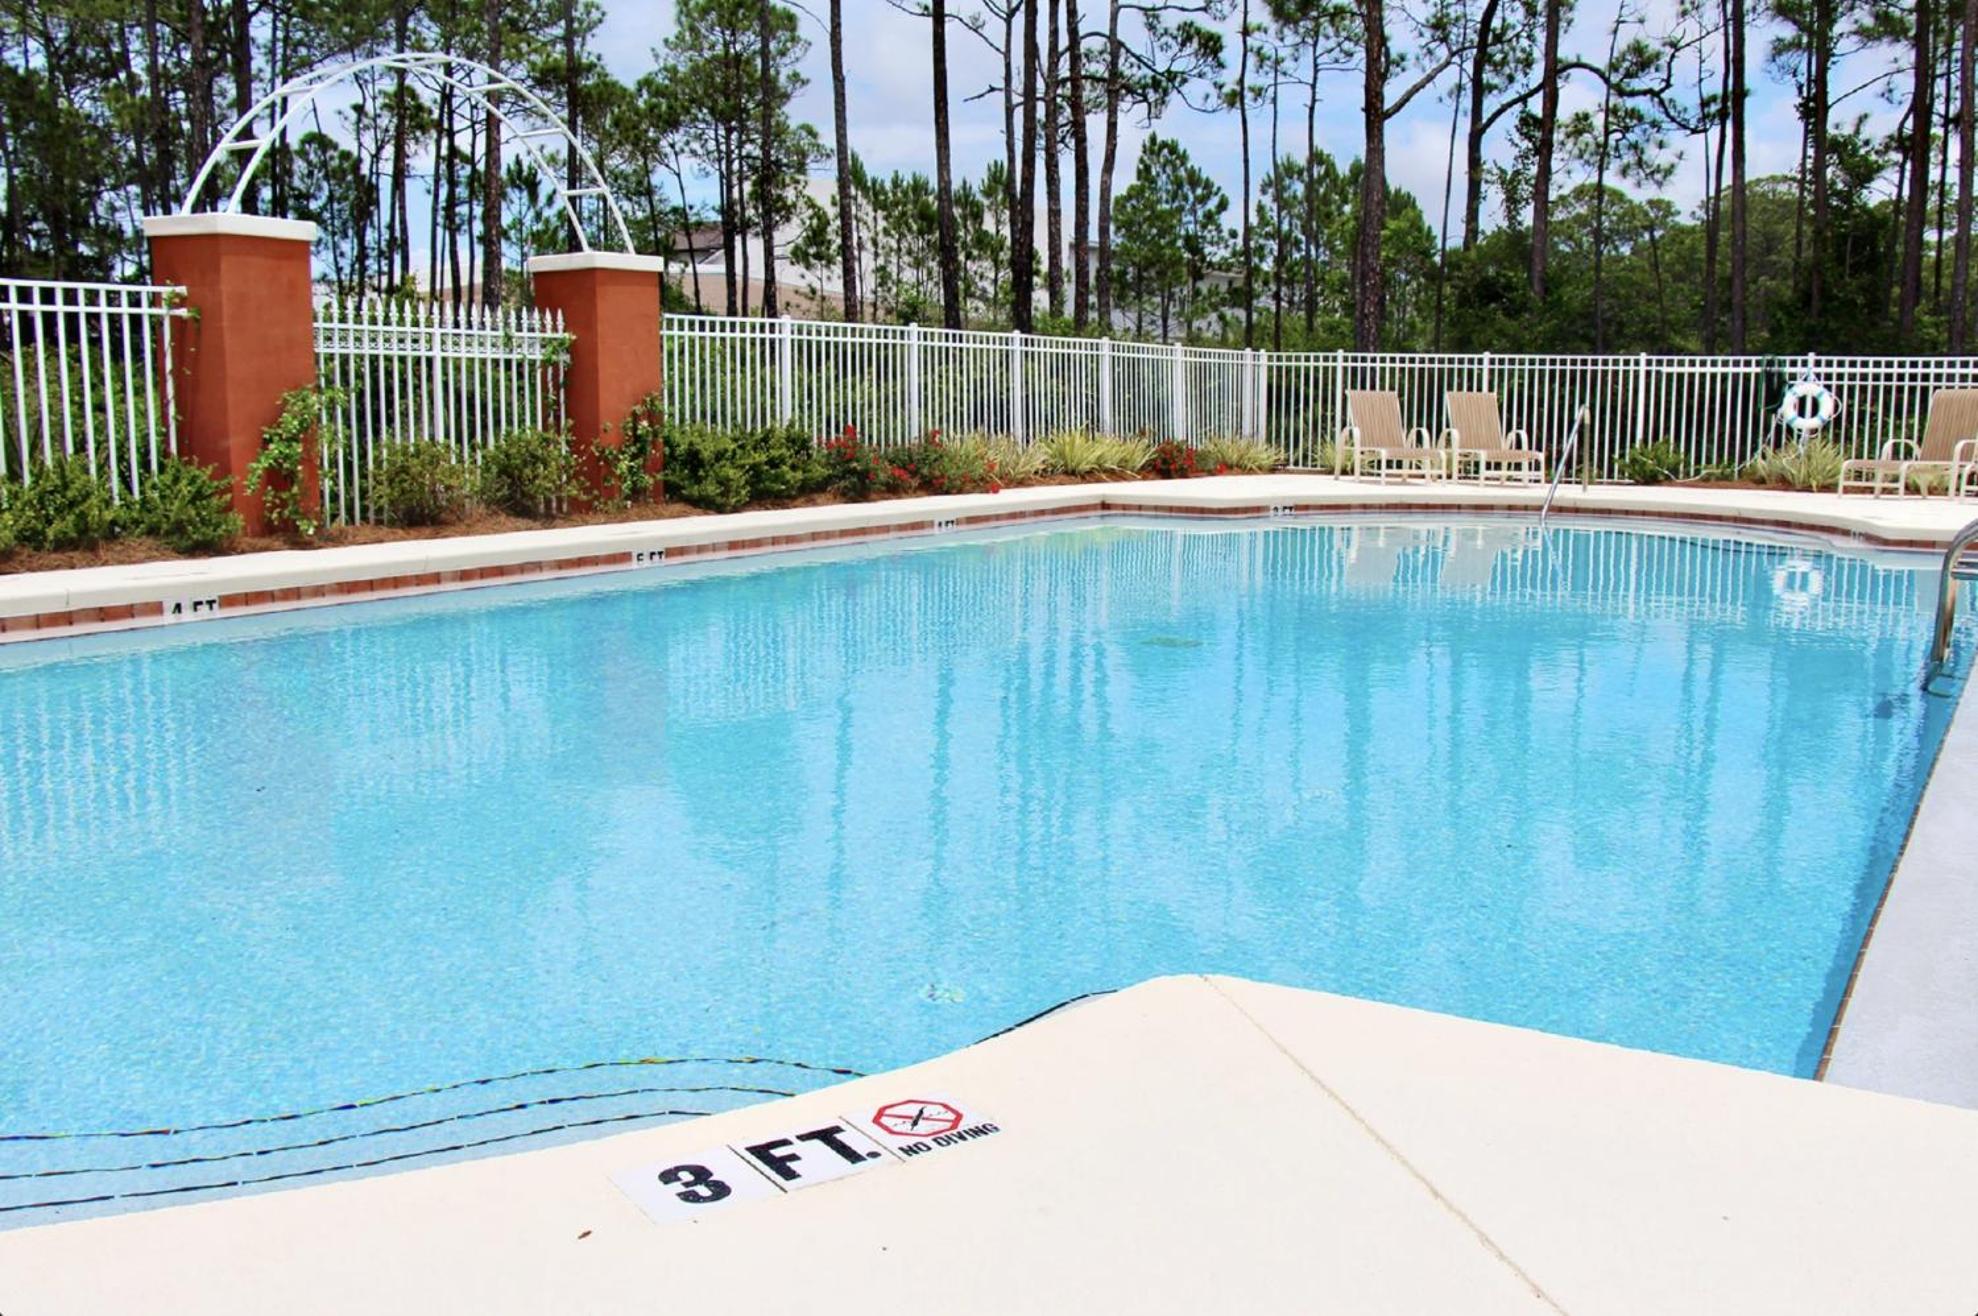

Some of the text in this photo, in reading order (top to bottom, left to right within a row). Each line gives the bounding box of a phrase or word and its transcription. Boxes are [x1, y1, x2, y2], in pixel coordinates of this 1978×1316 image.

[193, 599, 217, 612] FT
[898, 1123, 1001, 1157] NO DIVING
[658, 1164, 732, 1203] 3
